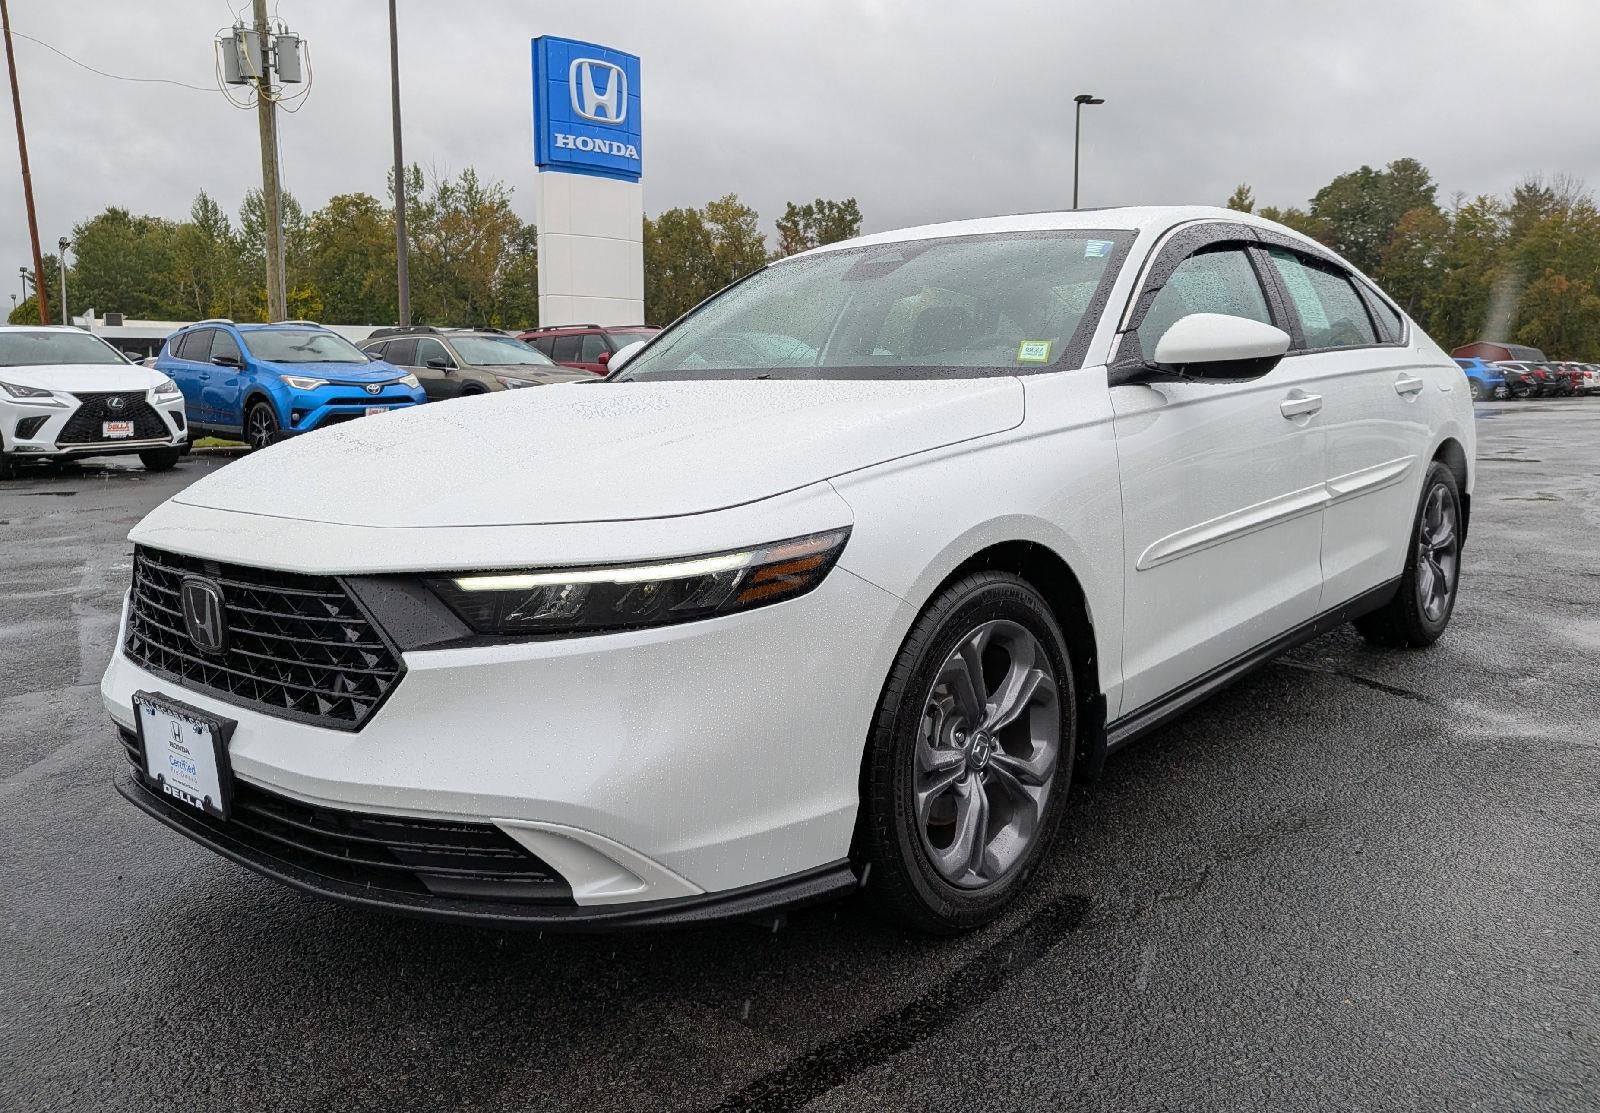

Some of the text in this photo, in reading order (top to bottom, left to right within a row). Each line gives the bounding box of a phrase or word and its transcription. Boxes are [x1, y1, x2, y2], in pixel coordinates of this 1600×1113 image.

[554, 133, 639, 159] HONDA
[168, 741, 191, 755] HONDA
[169, 755, 197, 775] Certified
[163, 783, 205, 811] DELLA
